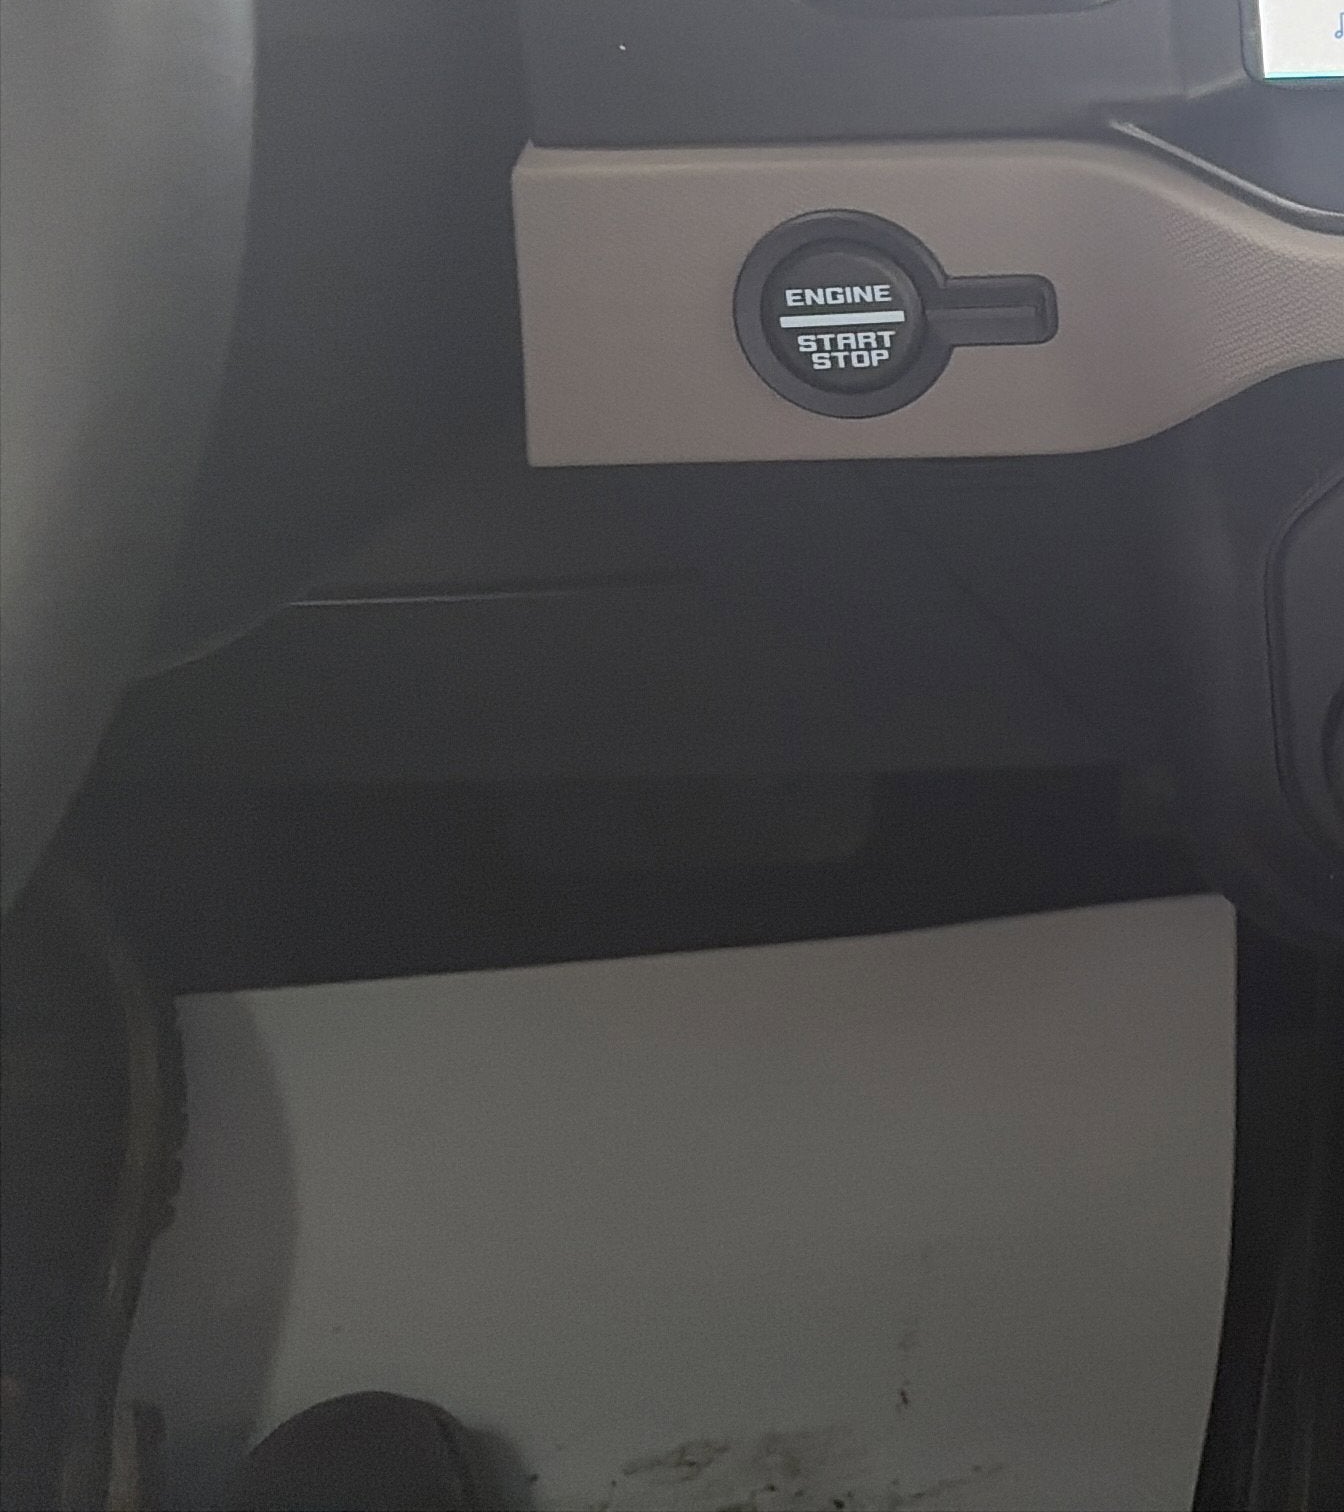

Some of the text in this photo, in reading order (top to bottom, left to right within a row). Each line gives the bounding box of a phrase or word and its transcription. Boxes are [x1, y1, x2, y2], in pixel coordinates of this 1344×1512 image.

[785, 285, 892, 307] ENGINE
[797, 331, 896, 352] START
[811, 350, 890, 370] STOP
